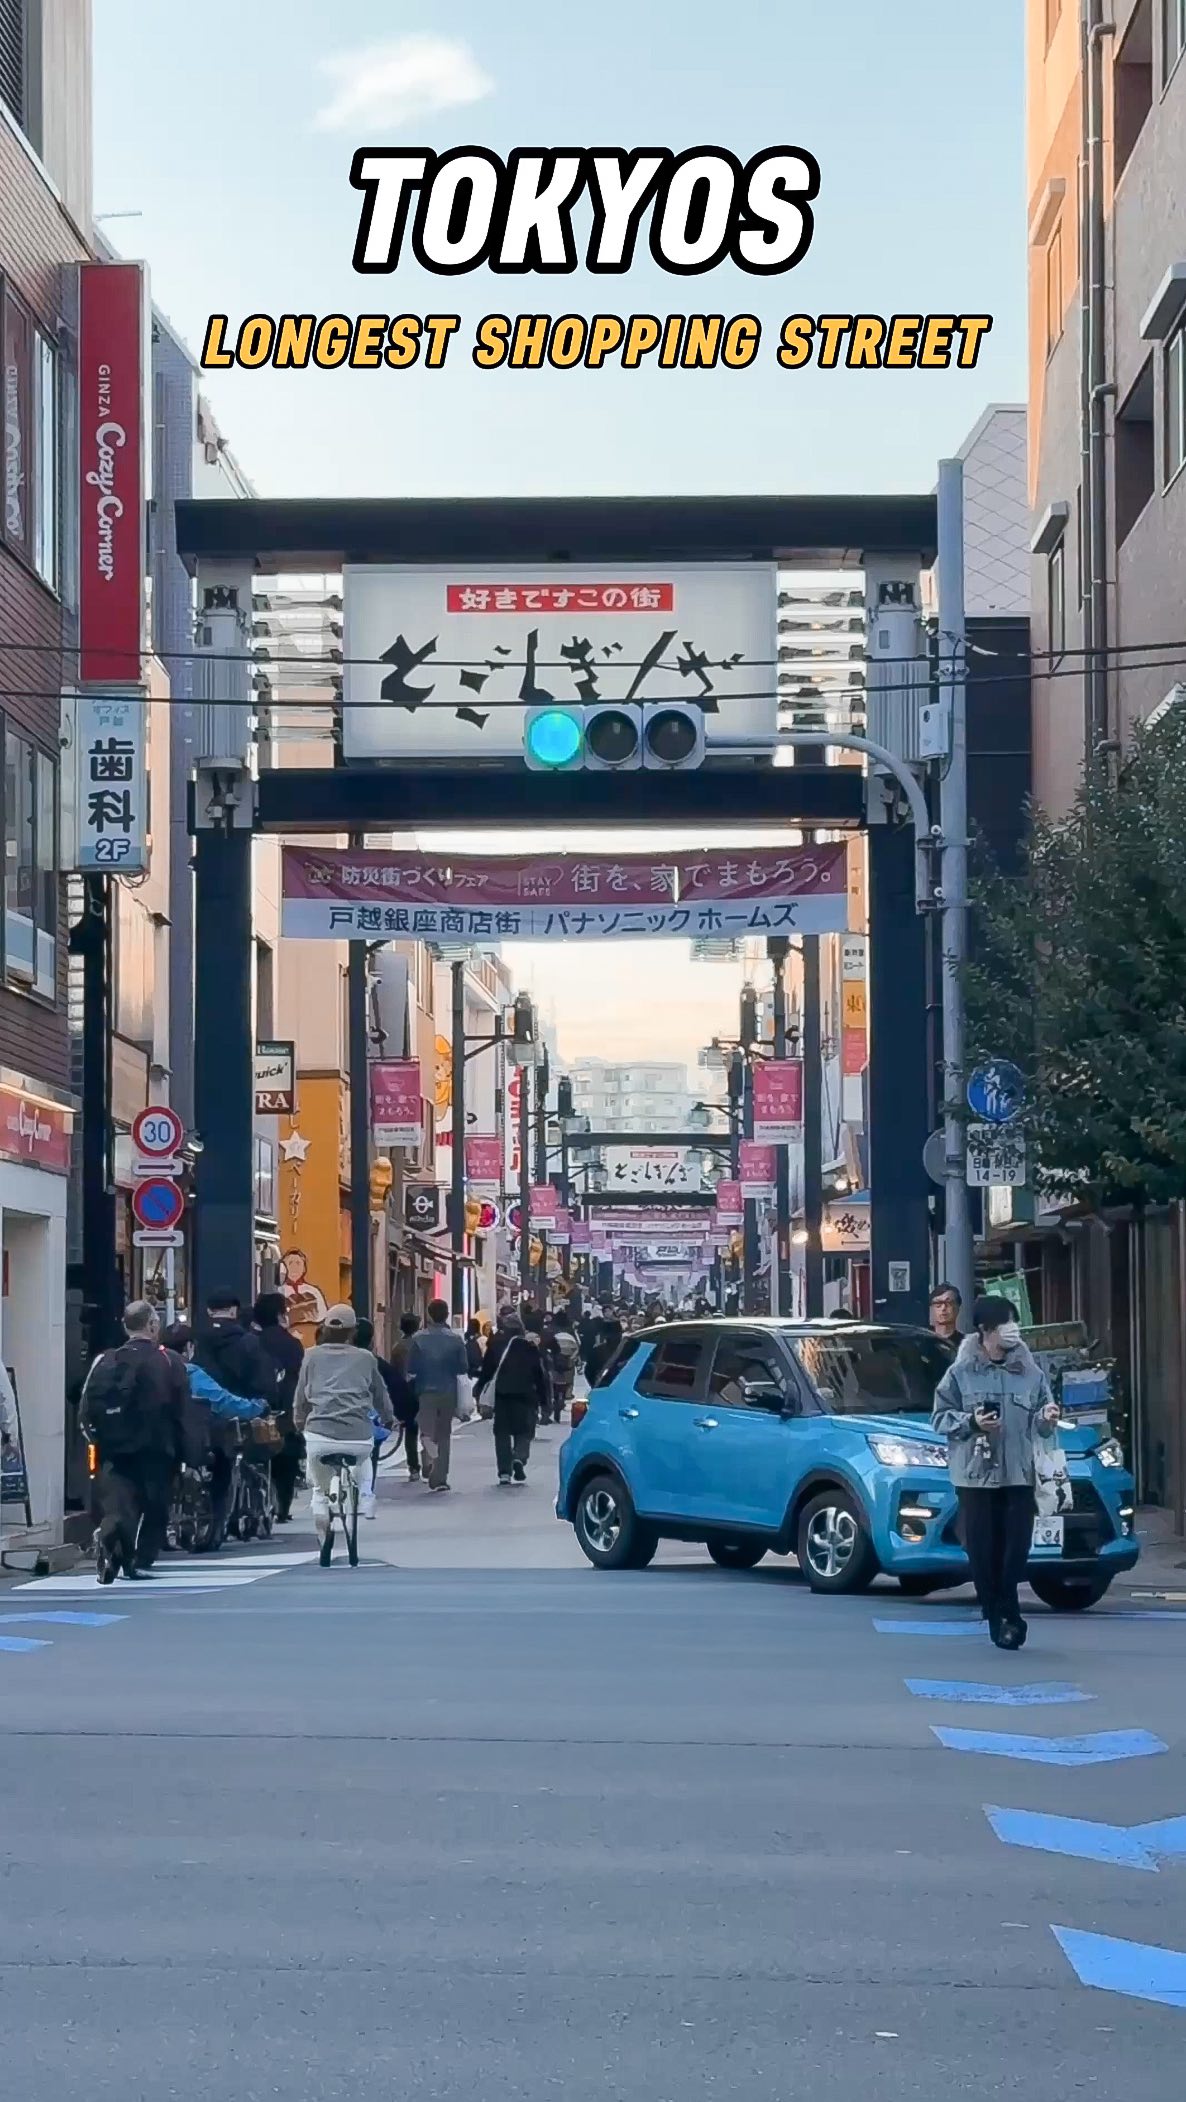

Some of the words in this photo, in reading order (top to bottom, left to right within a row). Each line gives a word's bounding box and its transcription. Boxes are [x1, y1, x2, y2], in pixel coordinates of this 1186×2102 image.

[98, 364, 111, 417] GINZA
[86, 422, 126, 496] Cozy
[97, 495, 123, 581] Corner
[460, 587, 661, 610] 好きですこの街
[88, 737, 135, 833] 歯科
[95, 838, 131, 862] 2F
[524, 876, 553, 887] STAY
[571, 858, 831, 893] 街を、家でまもろう。
[329, 906, 521, 934] 戸越銀座商店街
[544, 909, 690, 935] パナソニック
[698, 902, 799, 930] ホームズ
[144, 1121, 171, 1143] 30
[975, 1169, 1016, 1182] 14-19
